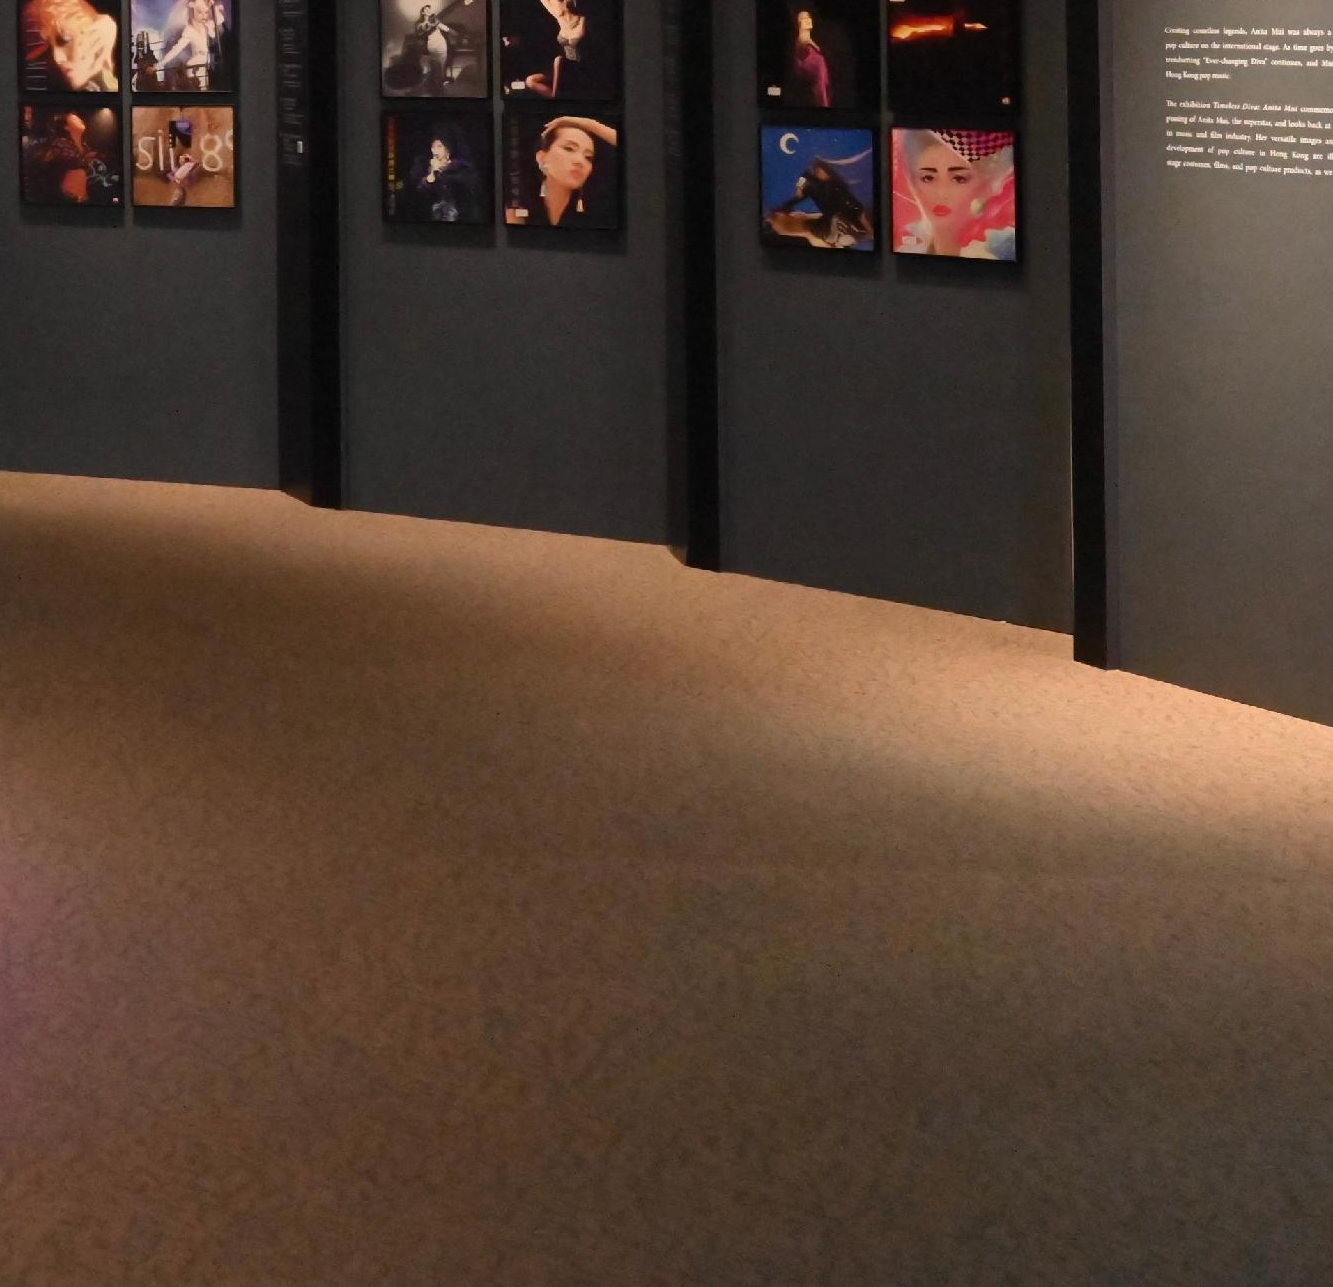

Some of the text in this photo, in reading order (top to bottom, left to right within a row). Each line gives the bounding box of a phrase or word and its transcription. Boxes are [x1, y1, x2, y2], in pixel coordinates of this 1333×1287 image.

[1222, 42, 1262, 50] international
[1288, 119, 1306, 128] looks
[1270, 150, 1288, 160] Hong
[1292, 151, 1309, 161] Kong
